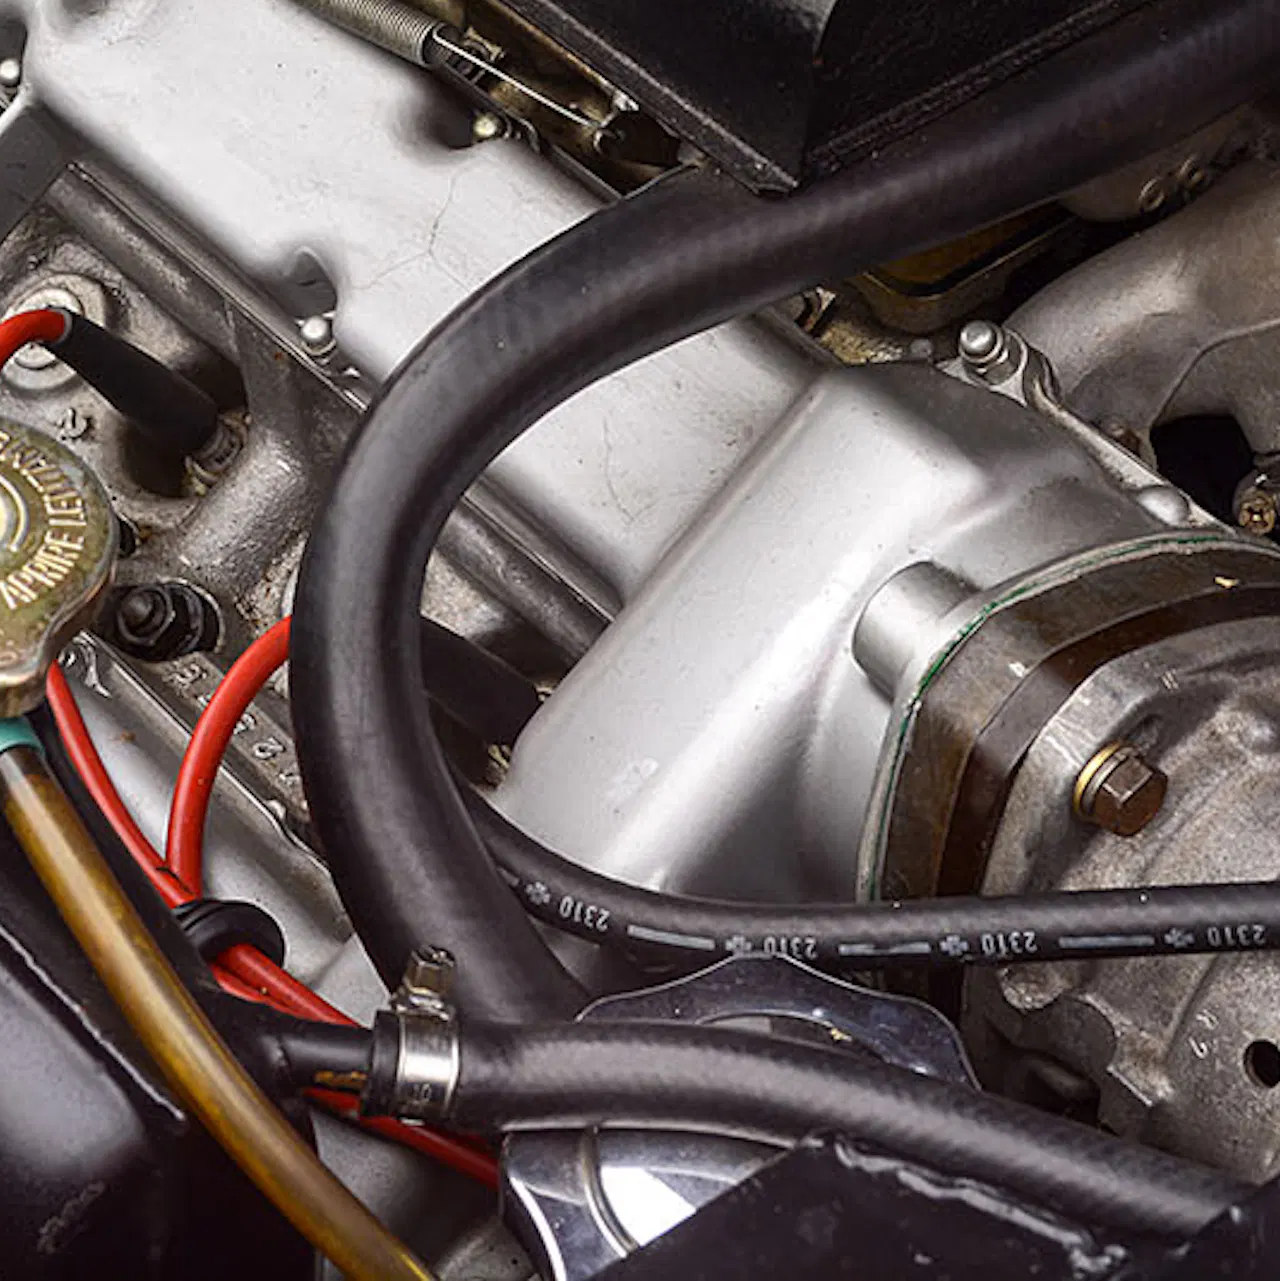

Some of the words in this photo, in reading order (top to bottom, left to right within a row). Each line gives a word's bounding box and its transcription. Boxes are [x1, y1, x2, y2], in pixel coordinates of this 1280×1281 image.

[559, 894, 611, 931] 2310
[980, 931, 1038, 955] 2310
[1207, 923, 1267, 947] 2310
[764, 936, 818, 959] 2310
